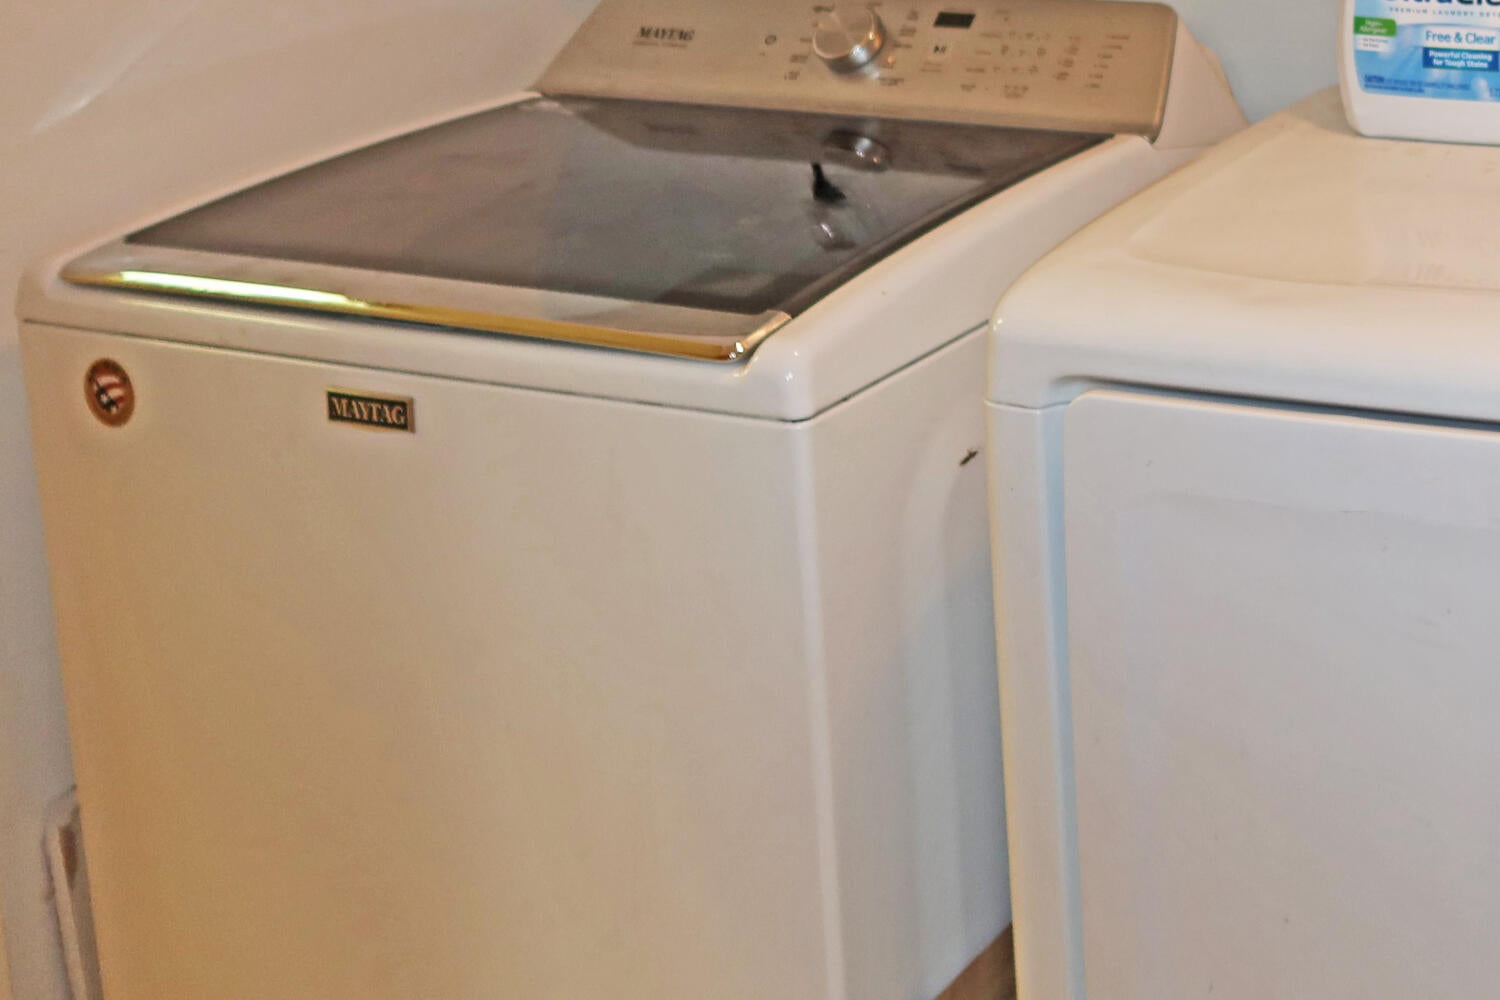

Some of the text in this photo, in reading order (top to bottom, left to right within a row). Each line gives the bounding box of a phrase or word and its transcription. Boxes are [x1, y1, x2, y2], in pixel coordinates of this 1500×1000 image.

[639, 26, 695, 41] MAYTAG
[1425, 30, 1496, 45] Free & Clear
[1428, 50, 1493, 62] Powerful Cleaning
[1444, 59, 1465, 68] Tough
[1466, 60, 1488, 68] Stains
[331, 397, 406, 425] MAYTAG
